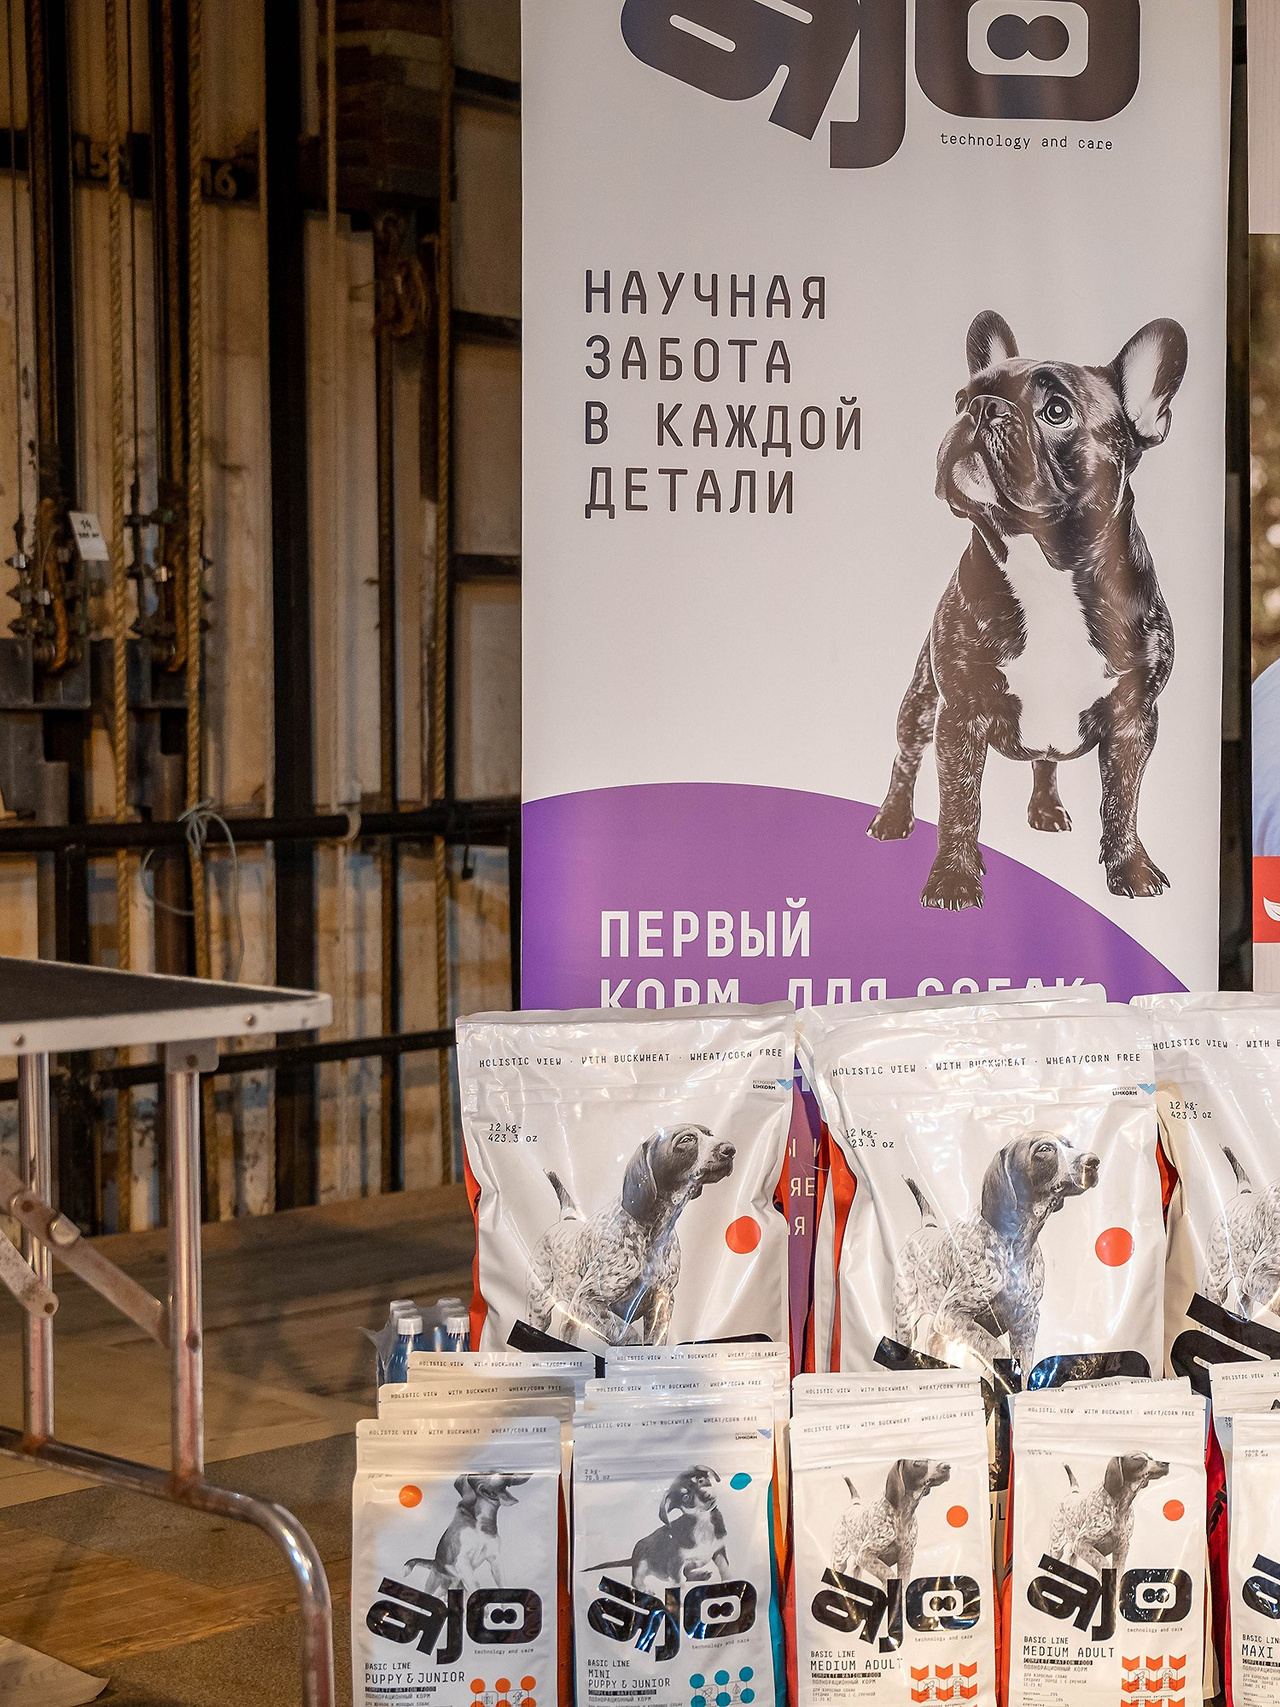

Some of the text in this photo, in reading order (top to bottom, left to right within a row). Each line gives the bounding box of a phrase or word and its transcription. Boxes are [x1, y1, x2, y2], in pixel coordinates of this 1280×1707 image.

[939, 132, 1114, 151] technology and care
[584, 268, 827, 320] НАУЧНАЯ
[584, 335, 793, 385] ЗАБОТА
[584, 396, 864, 458] В КАЖДОЙ
[584, 466, 796, 520] ДЕТАЛИ
[600, 896, 812, 958] ПЕРВЫЙ
[1153, 1038, 1201, 1050] HOLISTIC
[1206, 1039, 1228, 1049] VIEW
[1246, 1039, 1270, 1048] WITH
[479, 1057, 530, 1068] HOLISTIC
[536, 1056, 563, 1066] VIEW
[613, 1053, 671, 1063] BUCKWHEAT
[690, 1050, 753, 1062] WHEAT/CORN
[759, 1048, 783, 1058] FREE
[832, 1066, 884, 1078] HOLISTIC
[890, 1064, 917, 1074] VIEW
[935, 1060, 963, 1071] WITH
[1045, 1054, 1110, 1066] WHEAT/CORN
[1116, 1053, 1142, 1062] FREE
[1169, 1100, 1182, 1109] 12
[1170, 1110, 1198, 1120] 423.3
[488, 1133, 538, 1143] 423.3 oz
[850, 1138, 895, 1149] 23.3 oz
[1024, 1636, 1069, 1645] BASIC LINE
[1242, 1634, 1263, 1643] BASIC
[837, 1650, 856, 1658] LINE
[1023, 1645, 1115, 1658] MEDIUM ADULT
[1241, 1644, 1273, 1659] MAXI
[365, 1662, 411, 1671] BASIC LINE
[588, 1659, 630, 1668] BASIC LINE
[810, 1659, 904, 1671] MEDIUM ADULT
[365, 1671, 465, 1684] PUPPY & JUNIOR
[588, 1669, 611, 1678] MINI
[588, 1678, 671, 1688] PUPPY & JUNIOR
